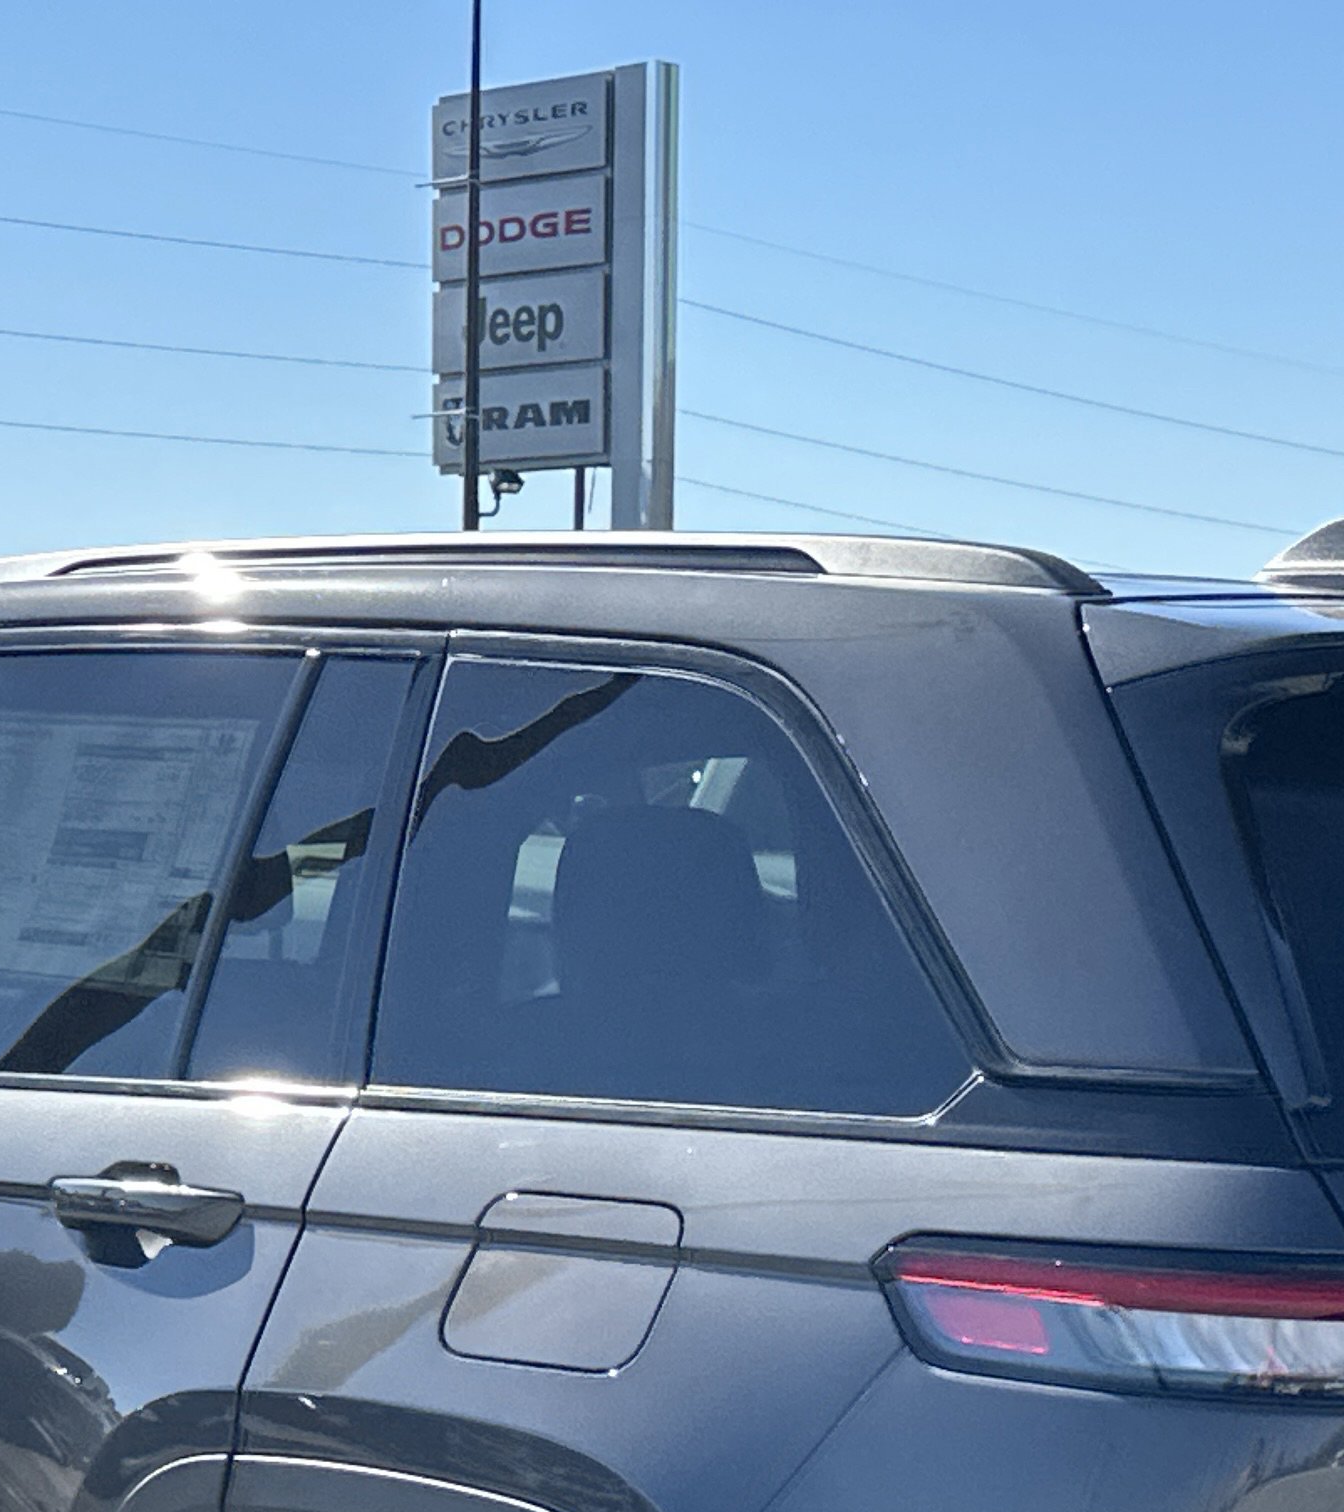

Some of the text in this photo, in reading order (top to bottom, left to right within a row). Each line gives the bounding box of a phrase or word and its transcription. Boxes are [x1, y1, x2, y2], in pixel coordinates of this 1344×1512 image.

[443, 101, 587, 136] CHRYSLER
[440, 208, 592, 251] DODGE
[482, 399, 590, 431] RAM
